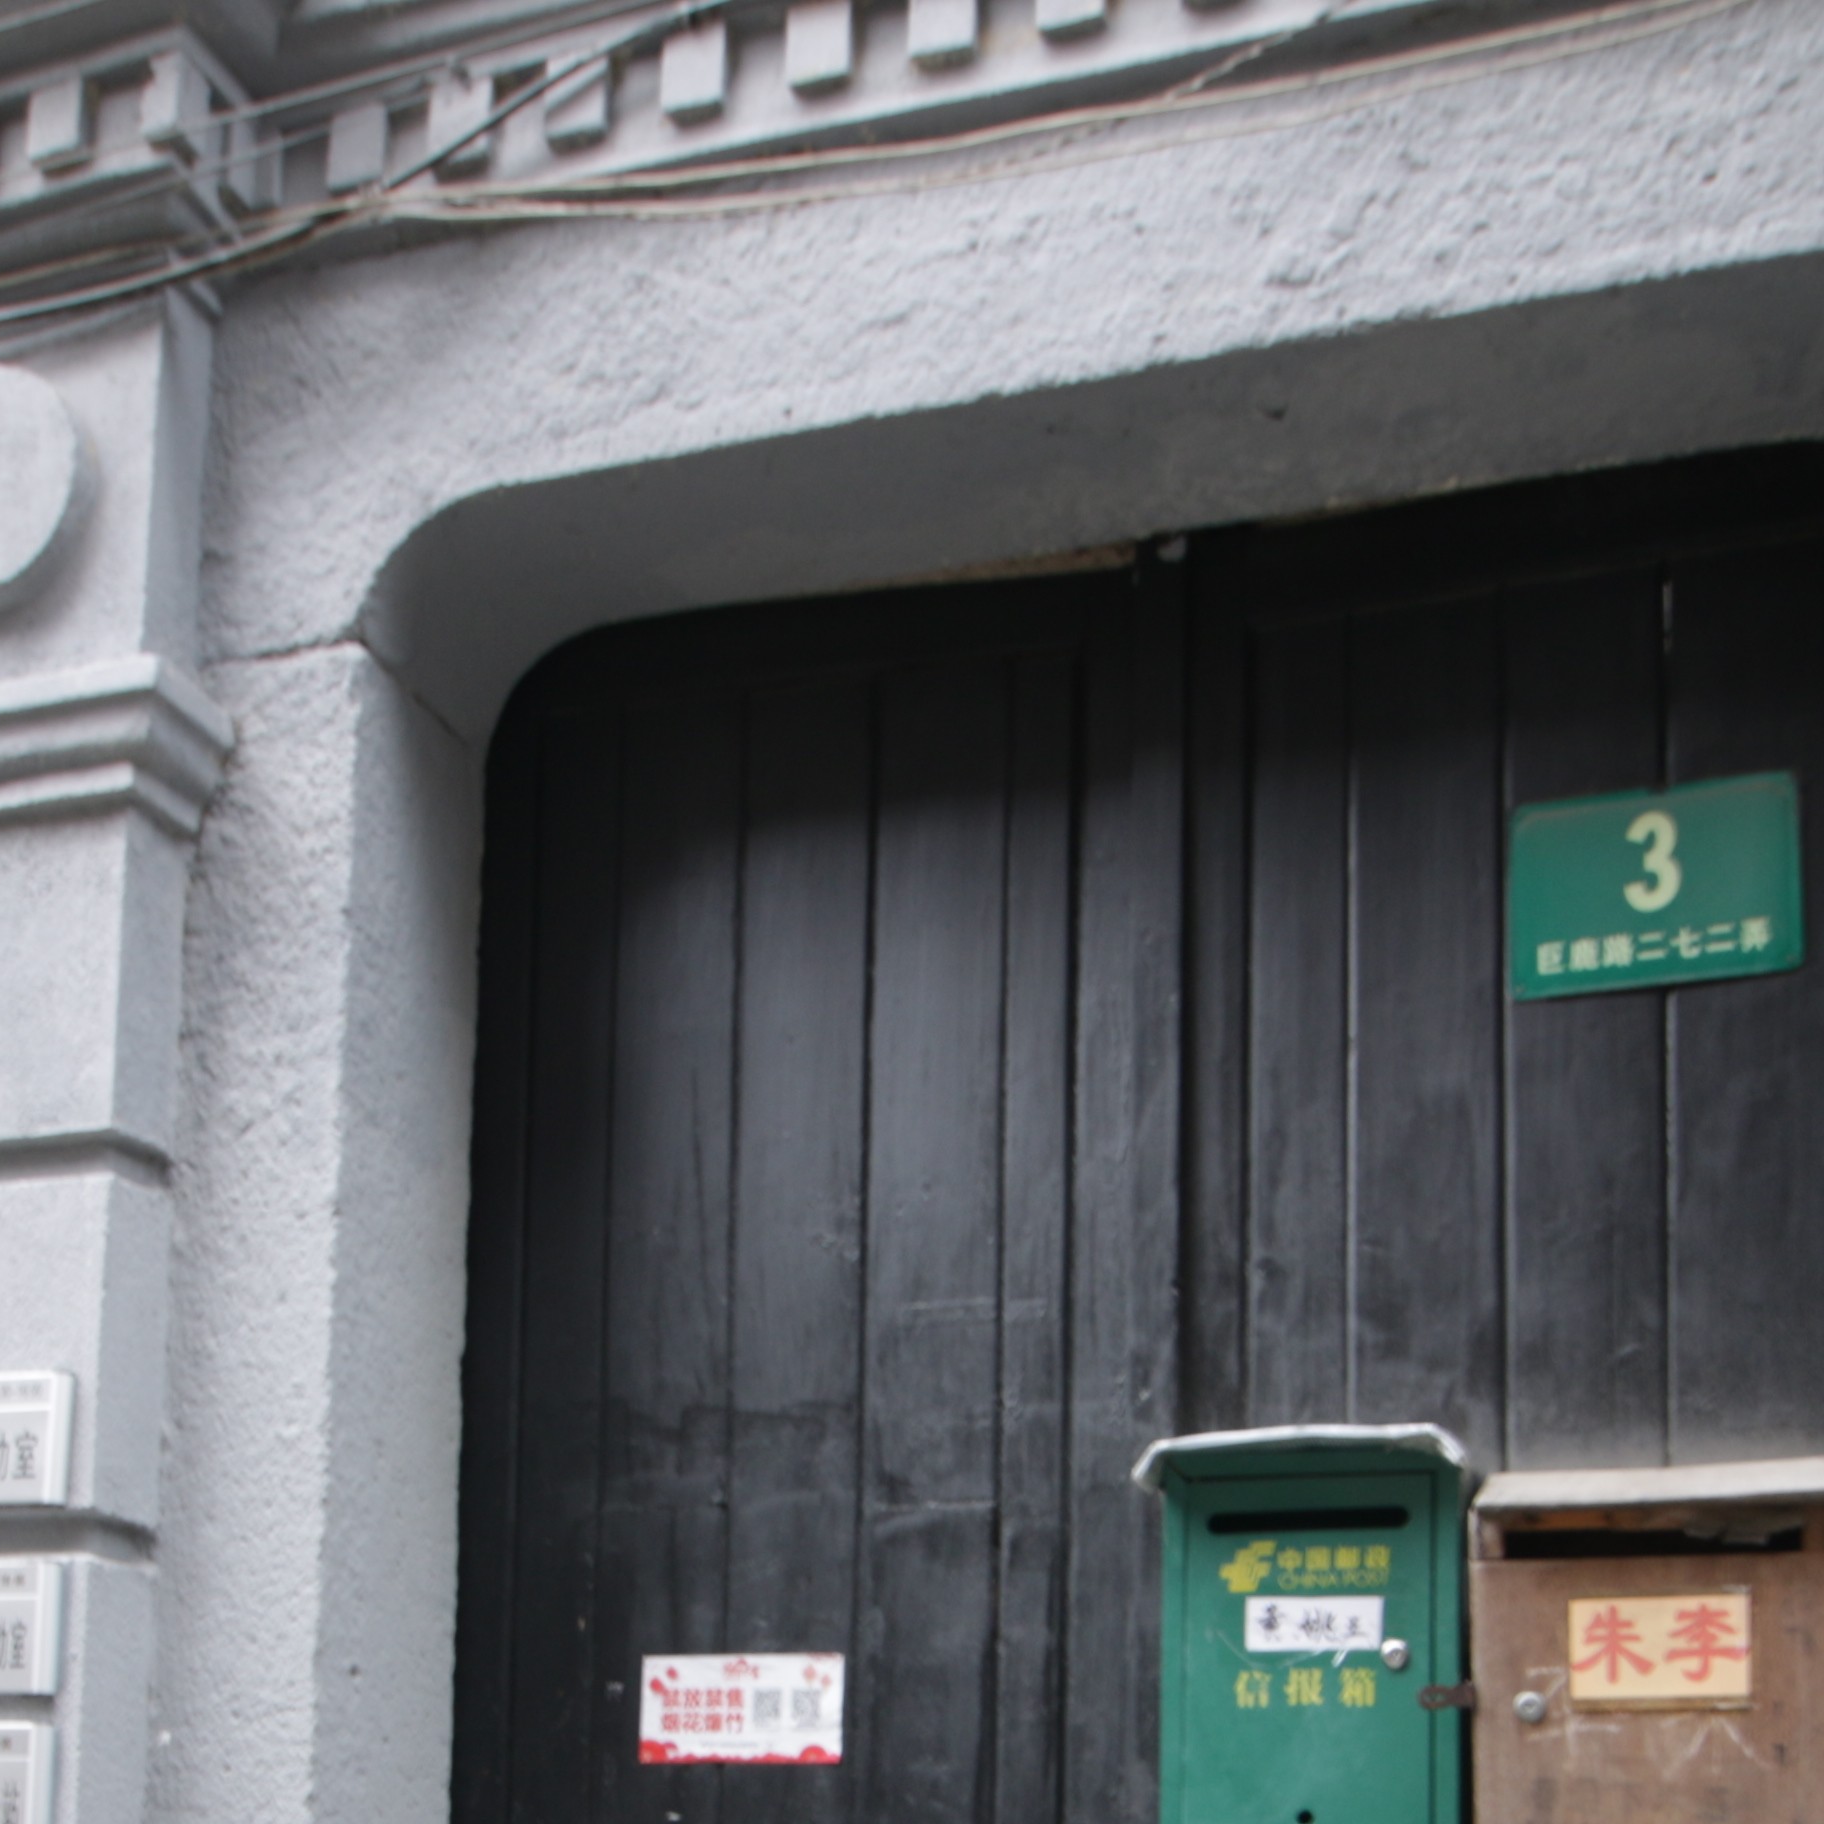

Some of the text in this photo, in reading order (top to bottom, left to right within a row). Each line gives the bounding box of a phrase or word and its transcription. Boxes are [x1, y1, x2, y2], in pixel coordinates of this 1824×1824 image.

[1623, 809, 1682, 914] 3
[1536, 915, 1774, 977] 巨鹿路二七二弄
[1277, 1544, 1392, 1571] 中国邮政
[1571, 1603, 1751, 1686] 朱李
[1234, 1667, 1378, 1709] 信报箱
